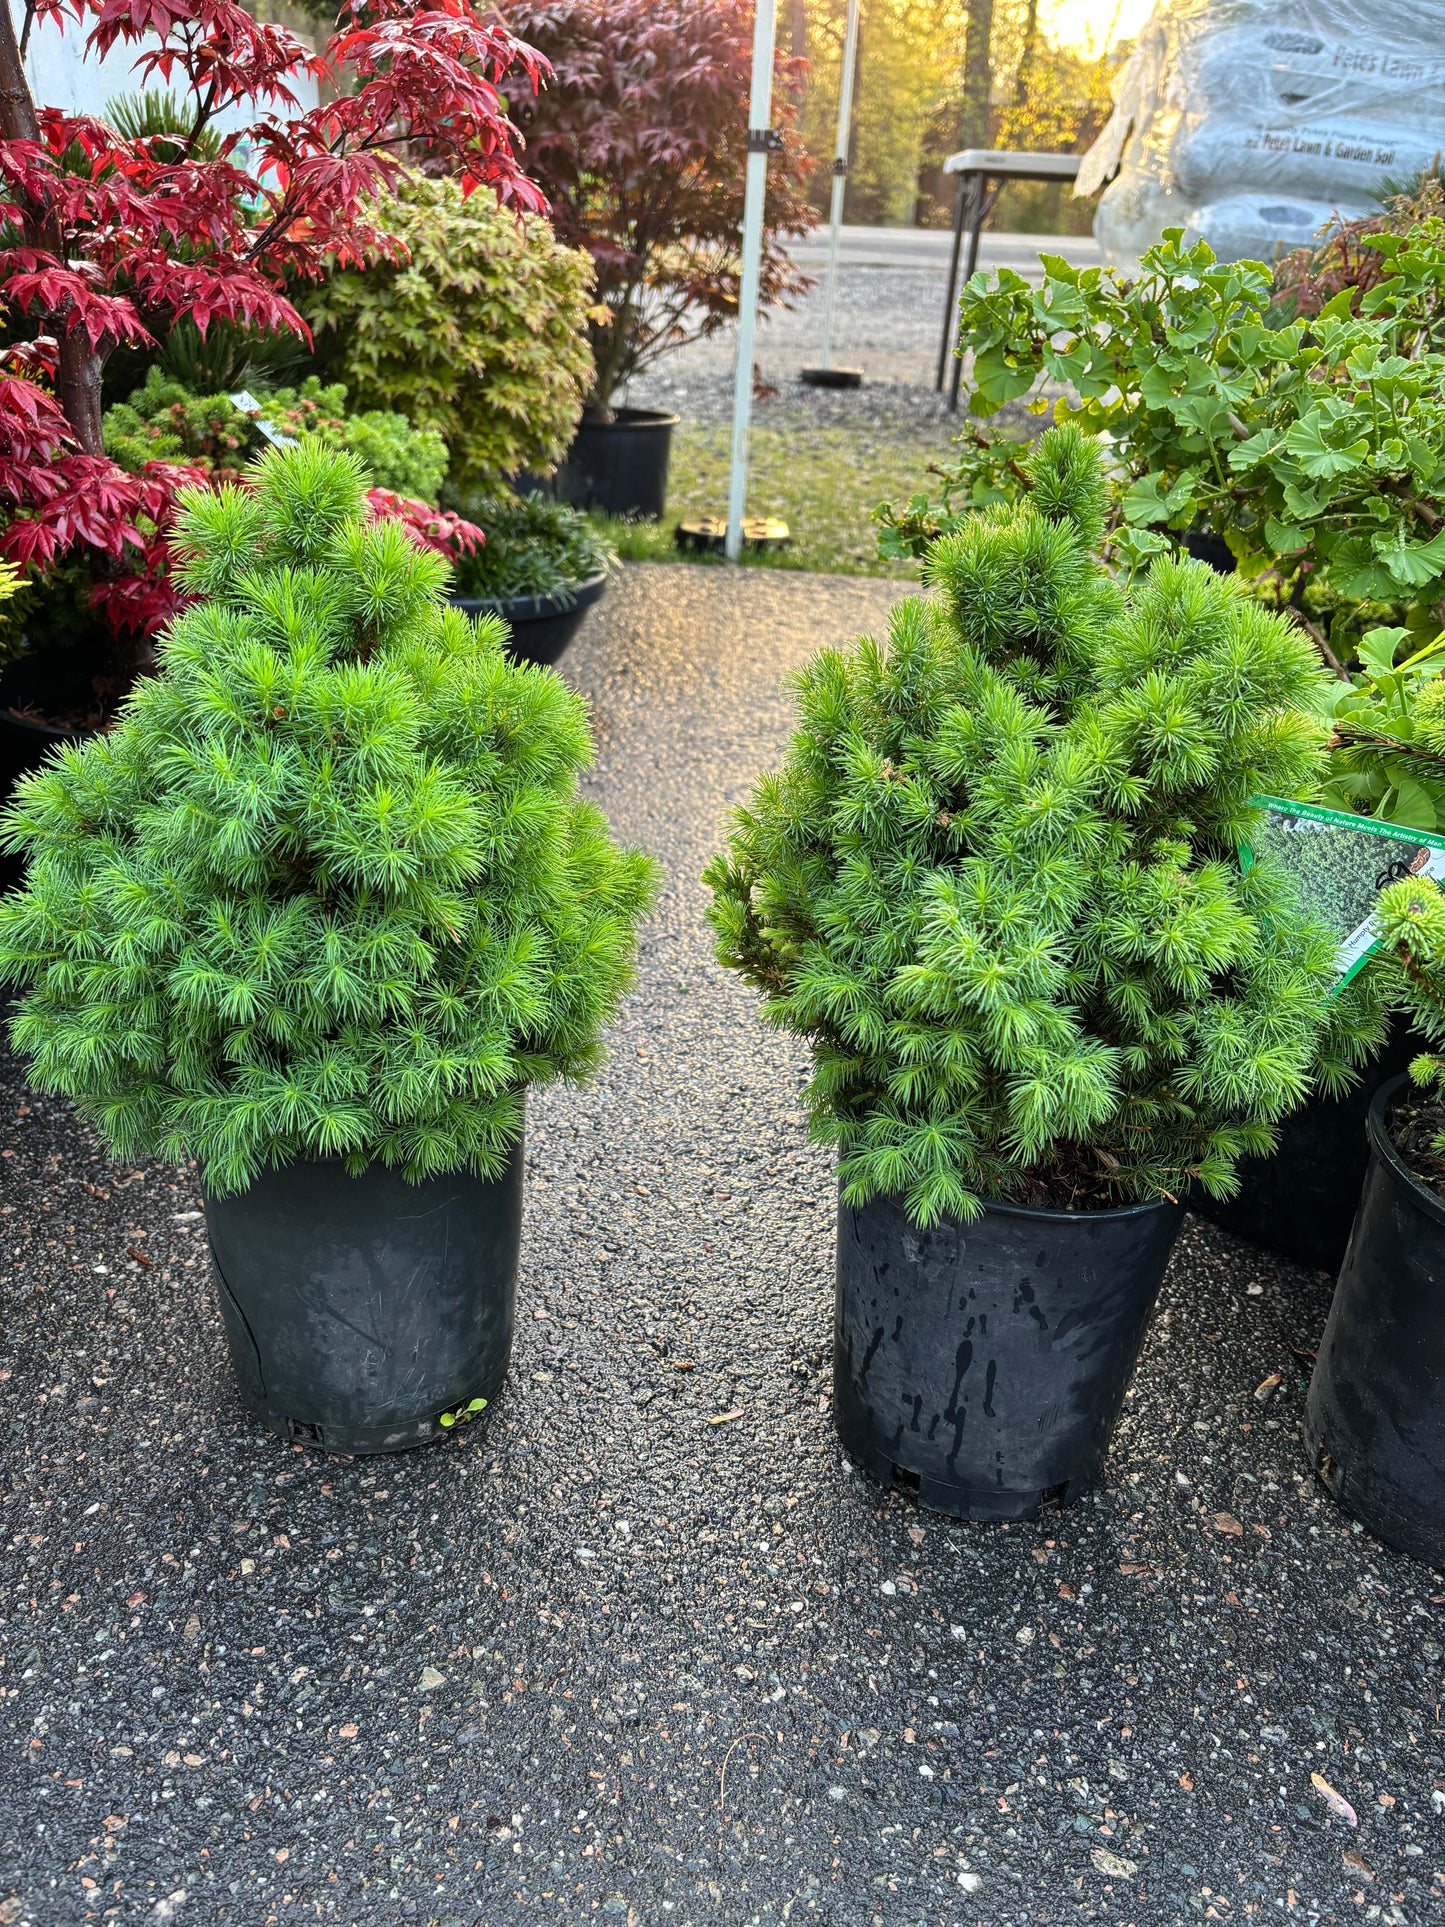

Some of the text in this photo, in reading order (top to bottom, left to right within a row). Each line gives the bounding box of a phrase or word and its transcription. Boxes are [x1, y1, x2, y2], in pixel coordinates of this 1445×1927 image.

[1293, 137, 1322, 154] Lawn
[1324, 140, 1333, 157] &
[1335, 142, 1374, 163] Garden
[1375, 147, 1397, 165] Soil
[1268, 802, 1288, 812] Where
[1289, 807, 1301, 815] the
[1301, 810, 1325, 821] Beauty
[1333, 818, 1356, 828] Nature
[1357, 823, 1378, 832] Meets
[1379, 828, 1392, 836] The
[1392, 831, 1418, 842] Artistry
[1347, 925, 1370, 948] Humpty
